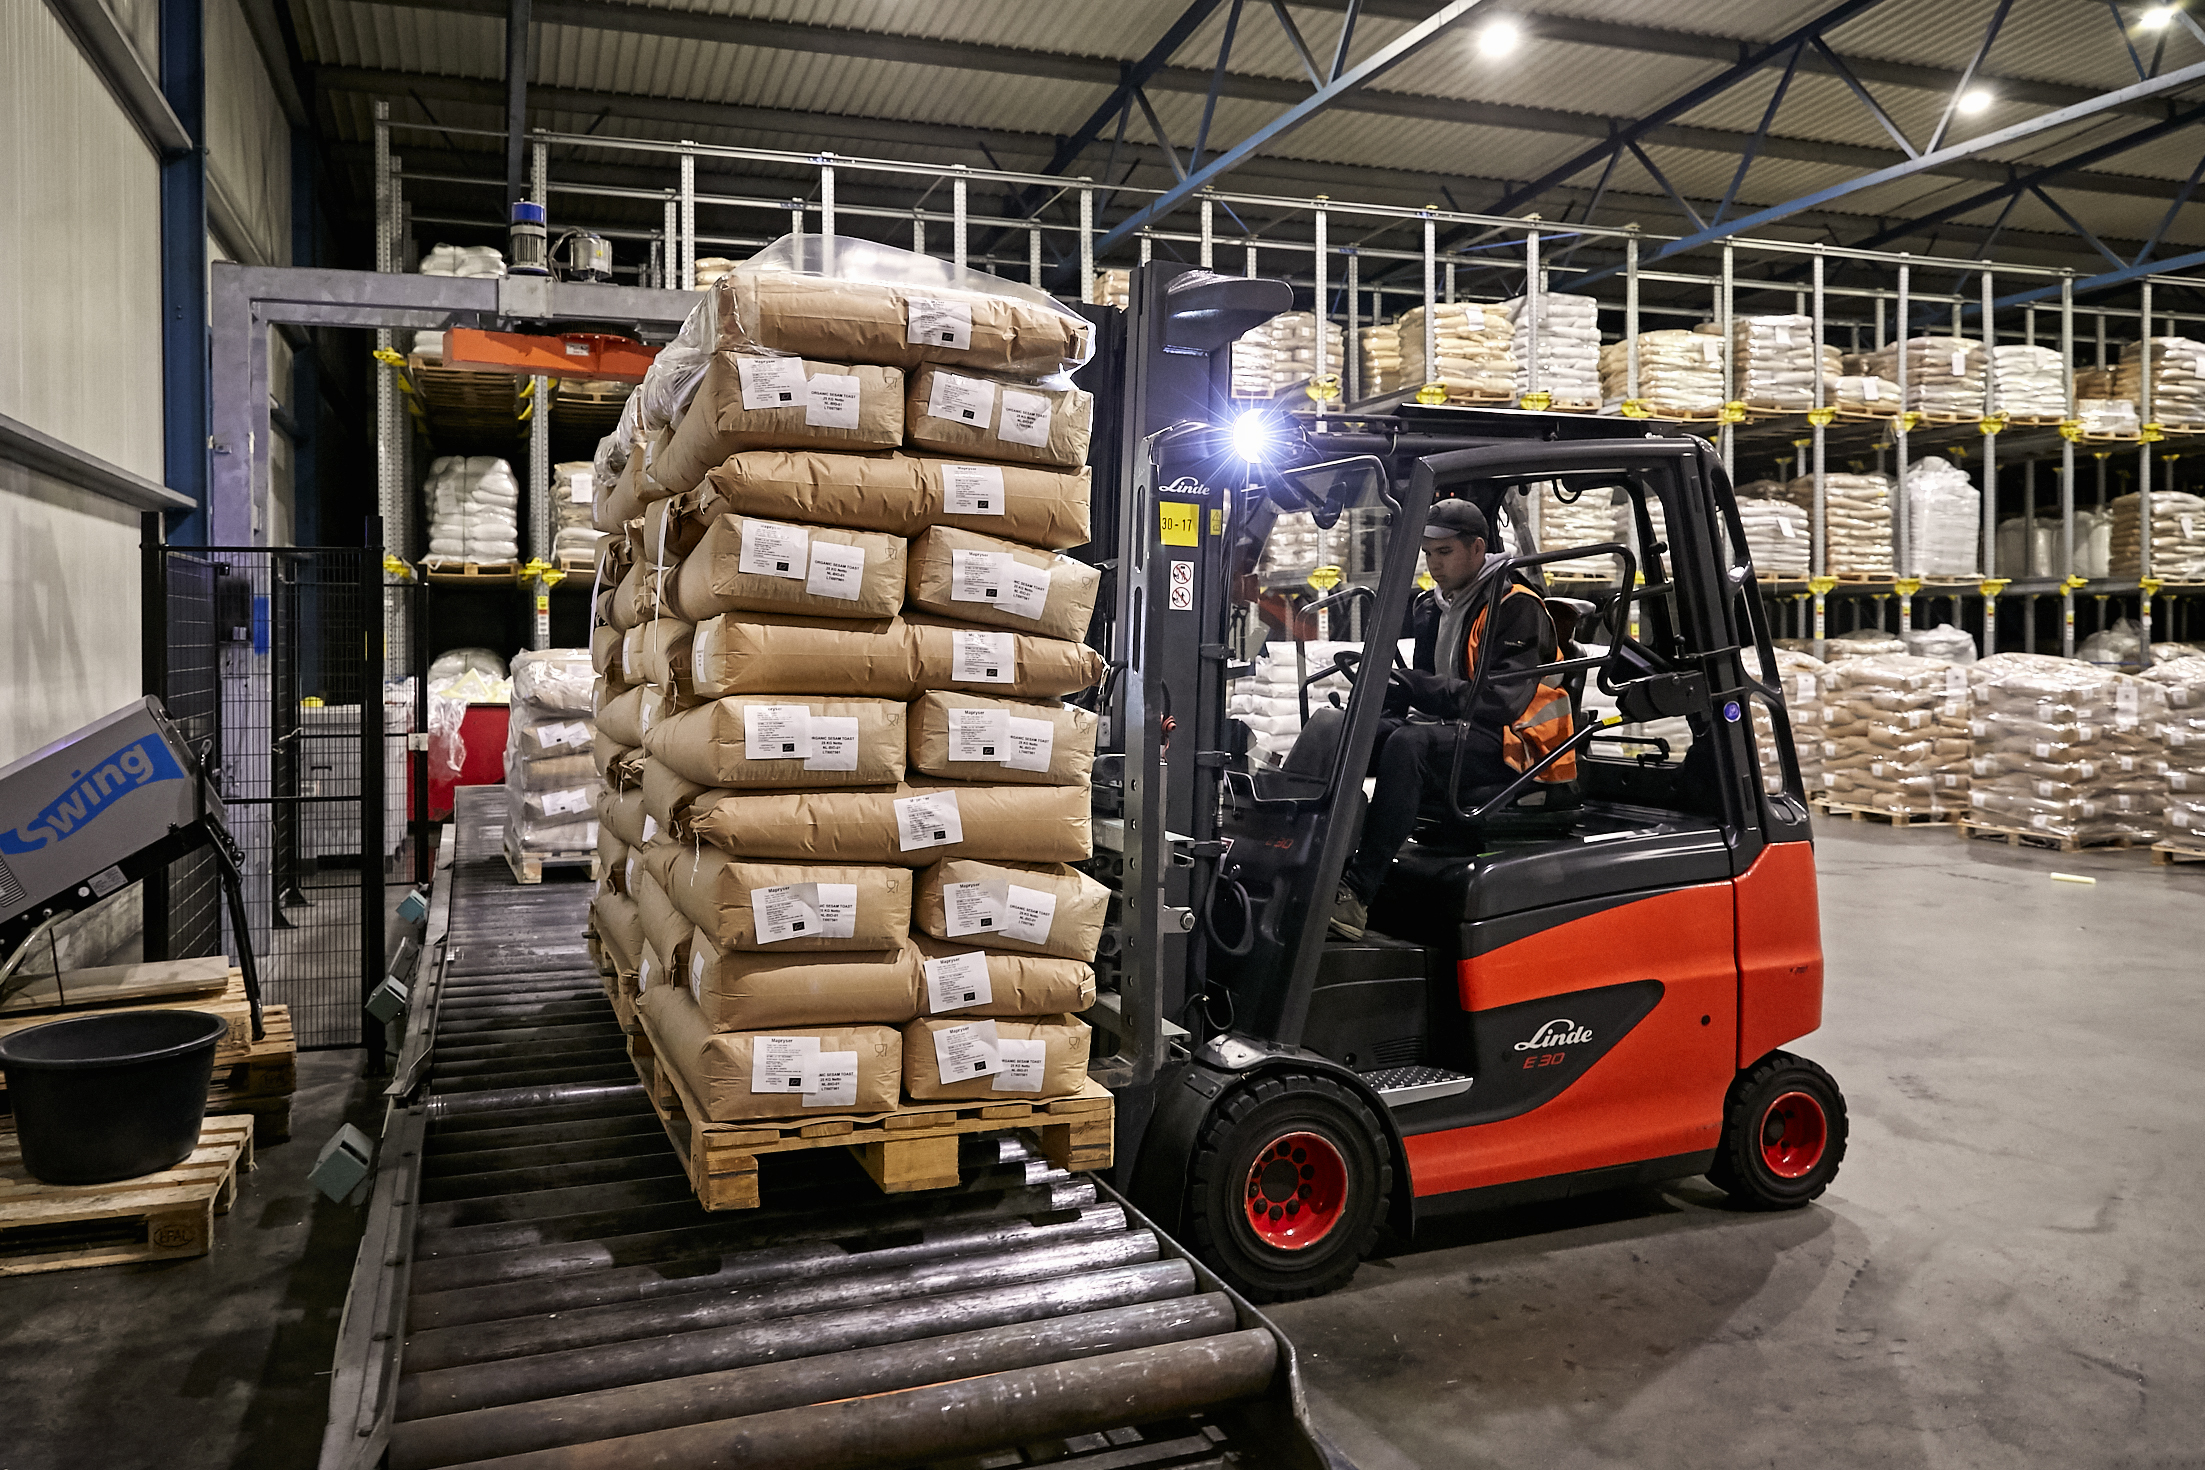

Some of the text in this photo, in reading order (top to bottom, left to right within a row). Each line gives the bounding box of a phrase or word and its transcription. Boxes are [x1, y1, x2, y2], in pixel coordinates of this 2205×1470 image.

[1159, 476, 1210, 495] Linde
[1162, 518, 1172, 530] 30
[1182, 519, 1192, 531] 17
[1514, 1019, 1592, 1051] Linde
[1523, 1052, 1565, 1069] E 30
